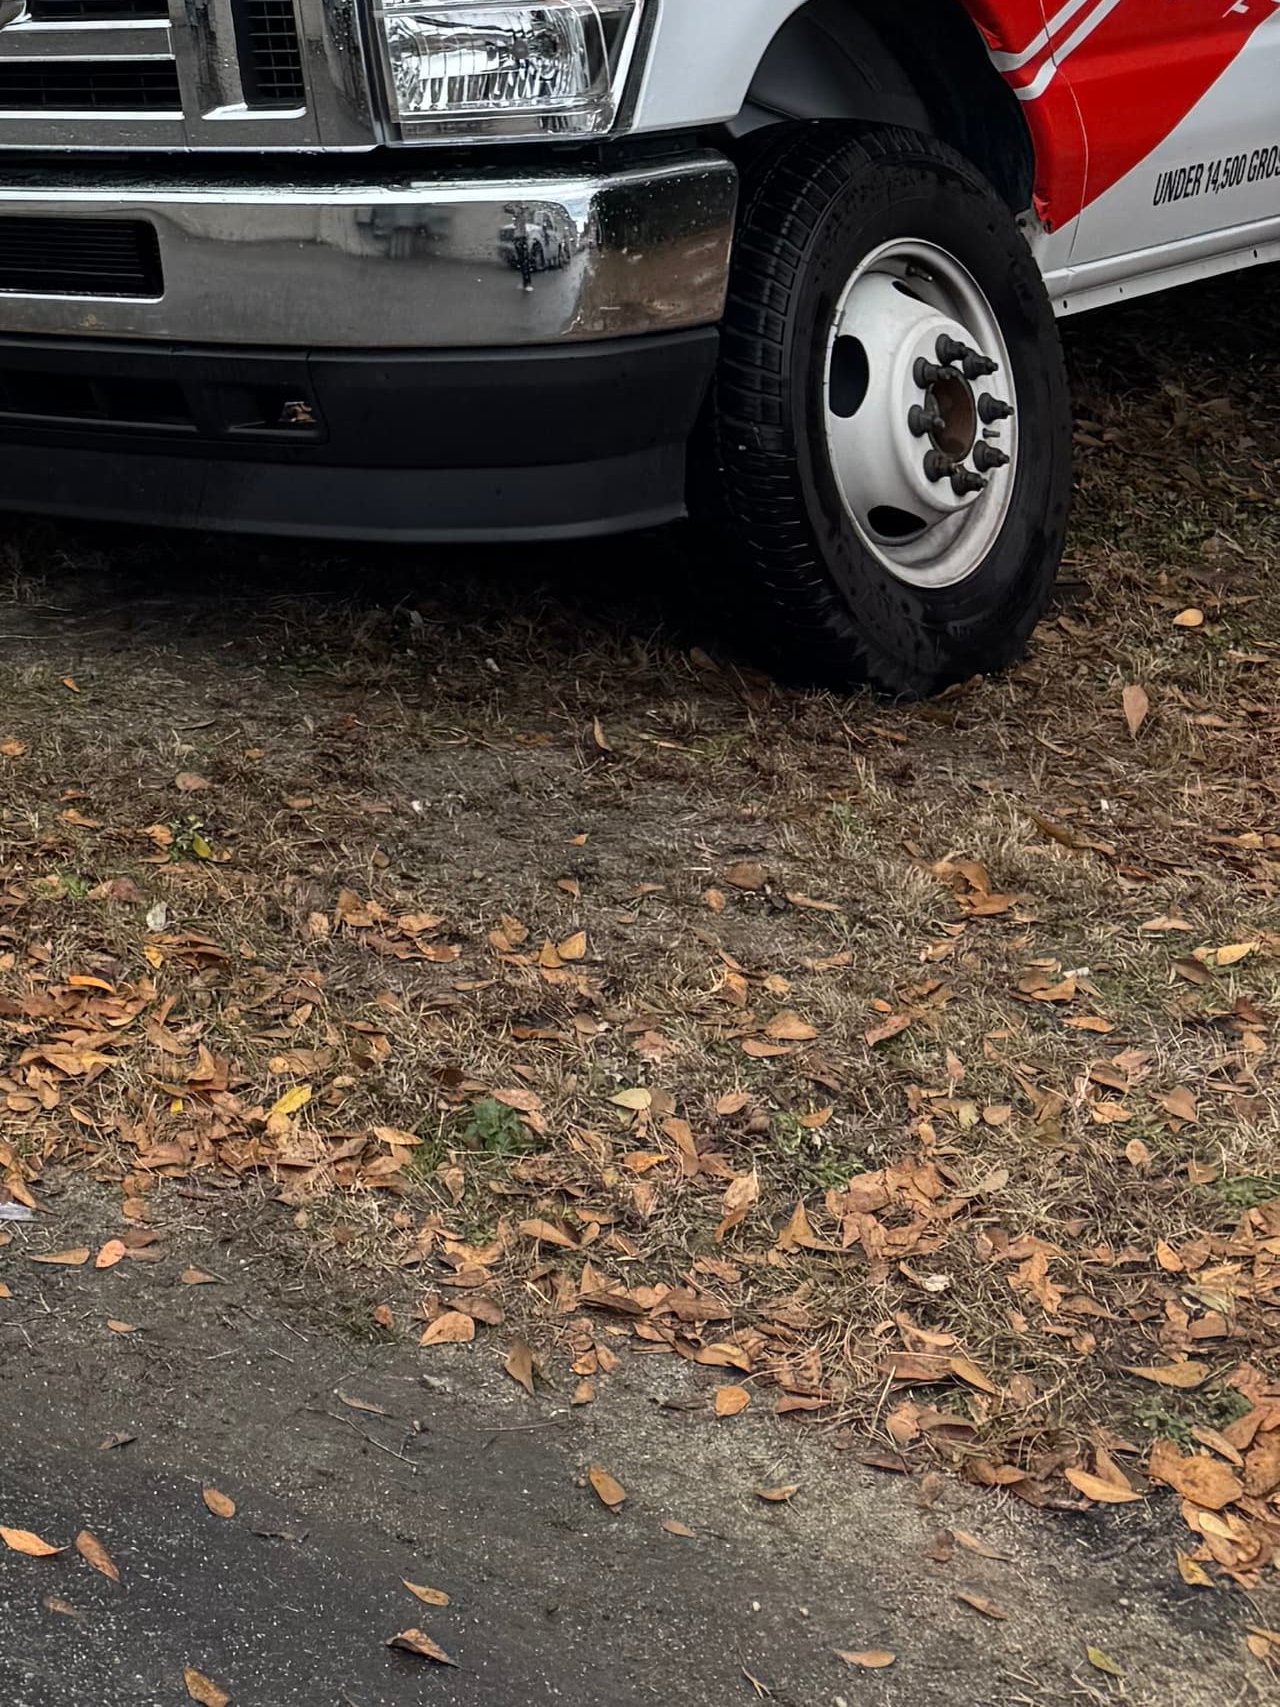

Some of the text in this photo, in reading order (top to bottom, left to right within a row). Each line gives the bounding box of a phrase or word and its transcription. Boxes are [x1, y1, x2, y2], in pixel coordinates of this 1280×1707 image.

[1153, 145, 1280, 206] UNDER 14,500 GRO
